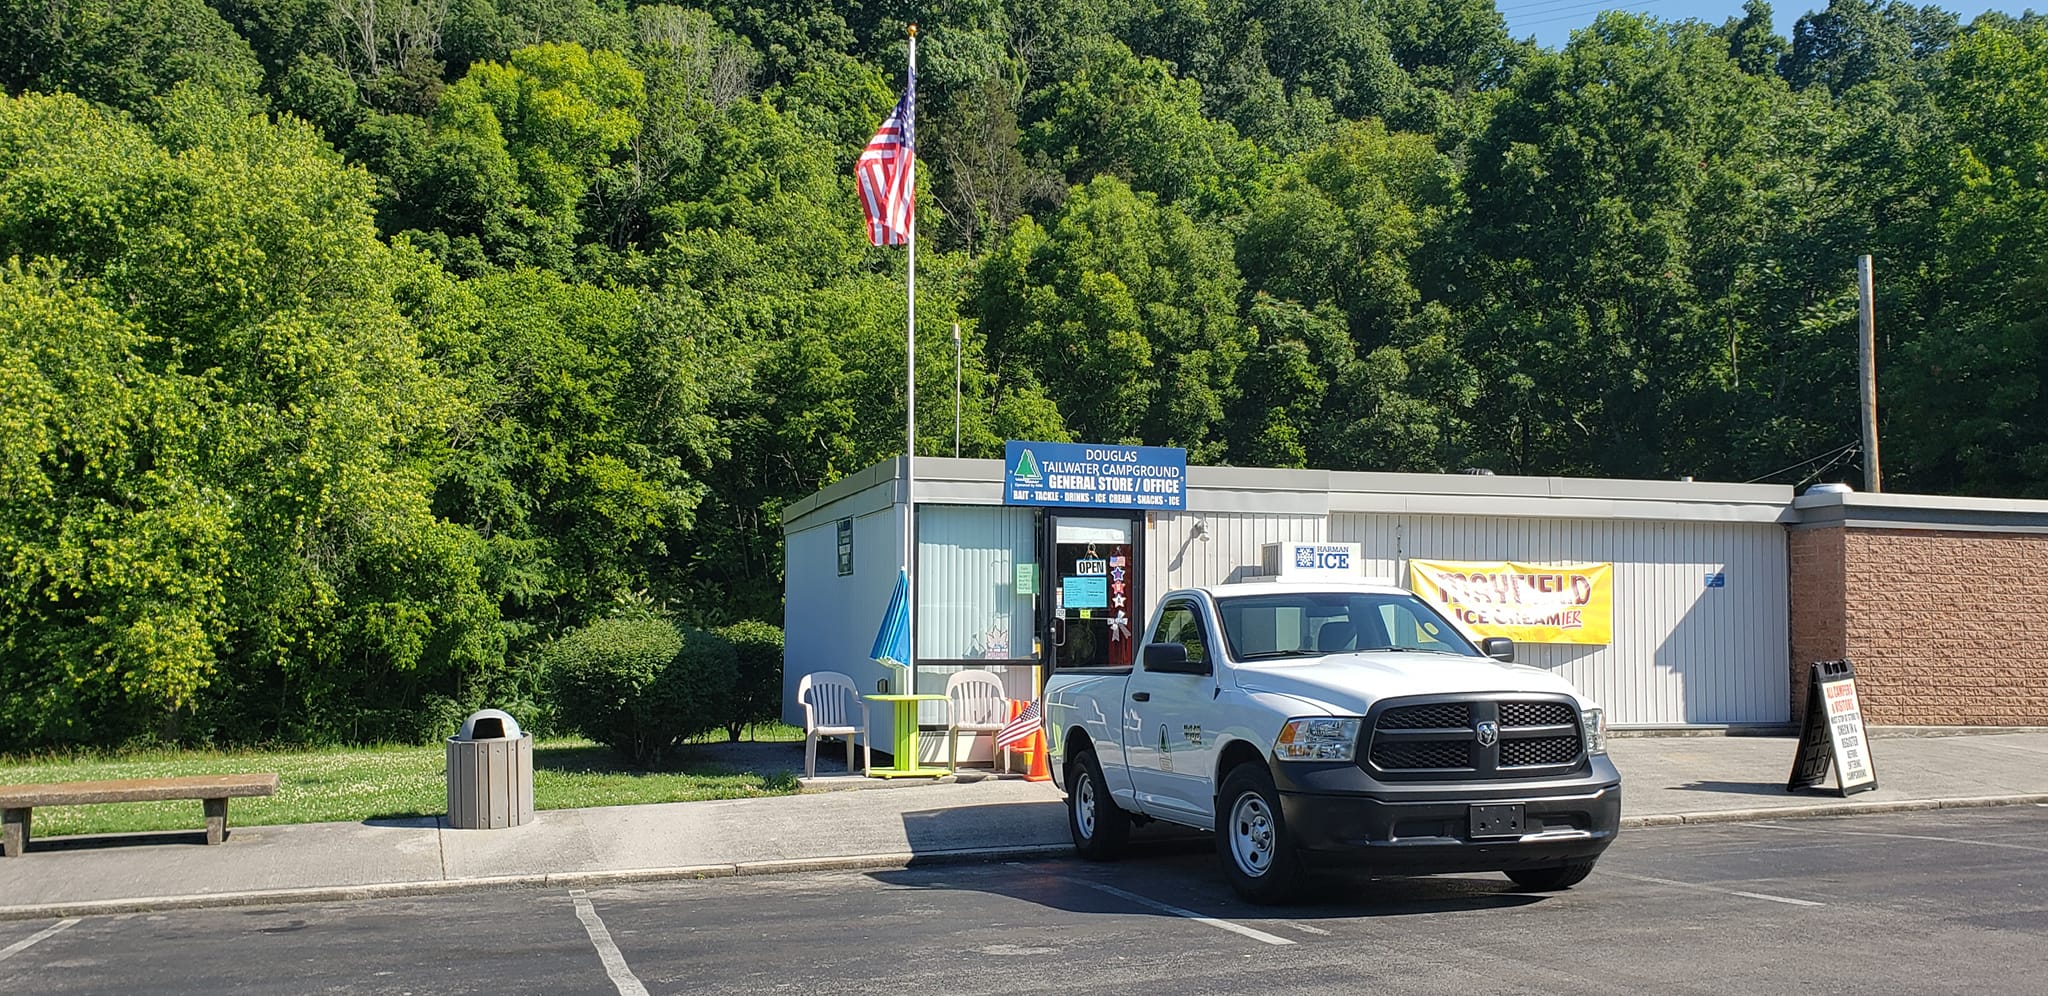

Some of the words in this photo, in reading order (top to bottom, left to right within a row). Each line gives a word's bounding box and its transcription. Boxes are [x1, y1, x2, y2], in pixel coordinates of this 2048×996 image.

[1086, 449, 1137, 462] DOUGLAS
[1042, 461, 1099, 475] TAILWATER
[1102, 463, 1179, 478] CAMPGROUND
[1049, 474, 1096, 490] GENERAL
[1098, 476, 1133, 492] STORE
[1143, 478, 1179, 493] OFFICE
[1013, 490, 1029, 500] BAIT
[1035, 491, 1059, 501] TACKLE
[1065, 492, 1089, 502] DRINKS
[1095, 493, 1106, 503] ICE
[1109, 494, 1131, 504] CREAM
[1137, 495, 1163, 505] SNACKS
[1169, 496, 1180, 506] ICE
[1317, 545, 1349, 553] HARMAN
[1079, 561, 1104, 574] OPEN
[1317, 552, 1349, 569] ICE
[1455, 608, 1489, 625] ICE
